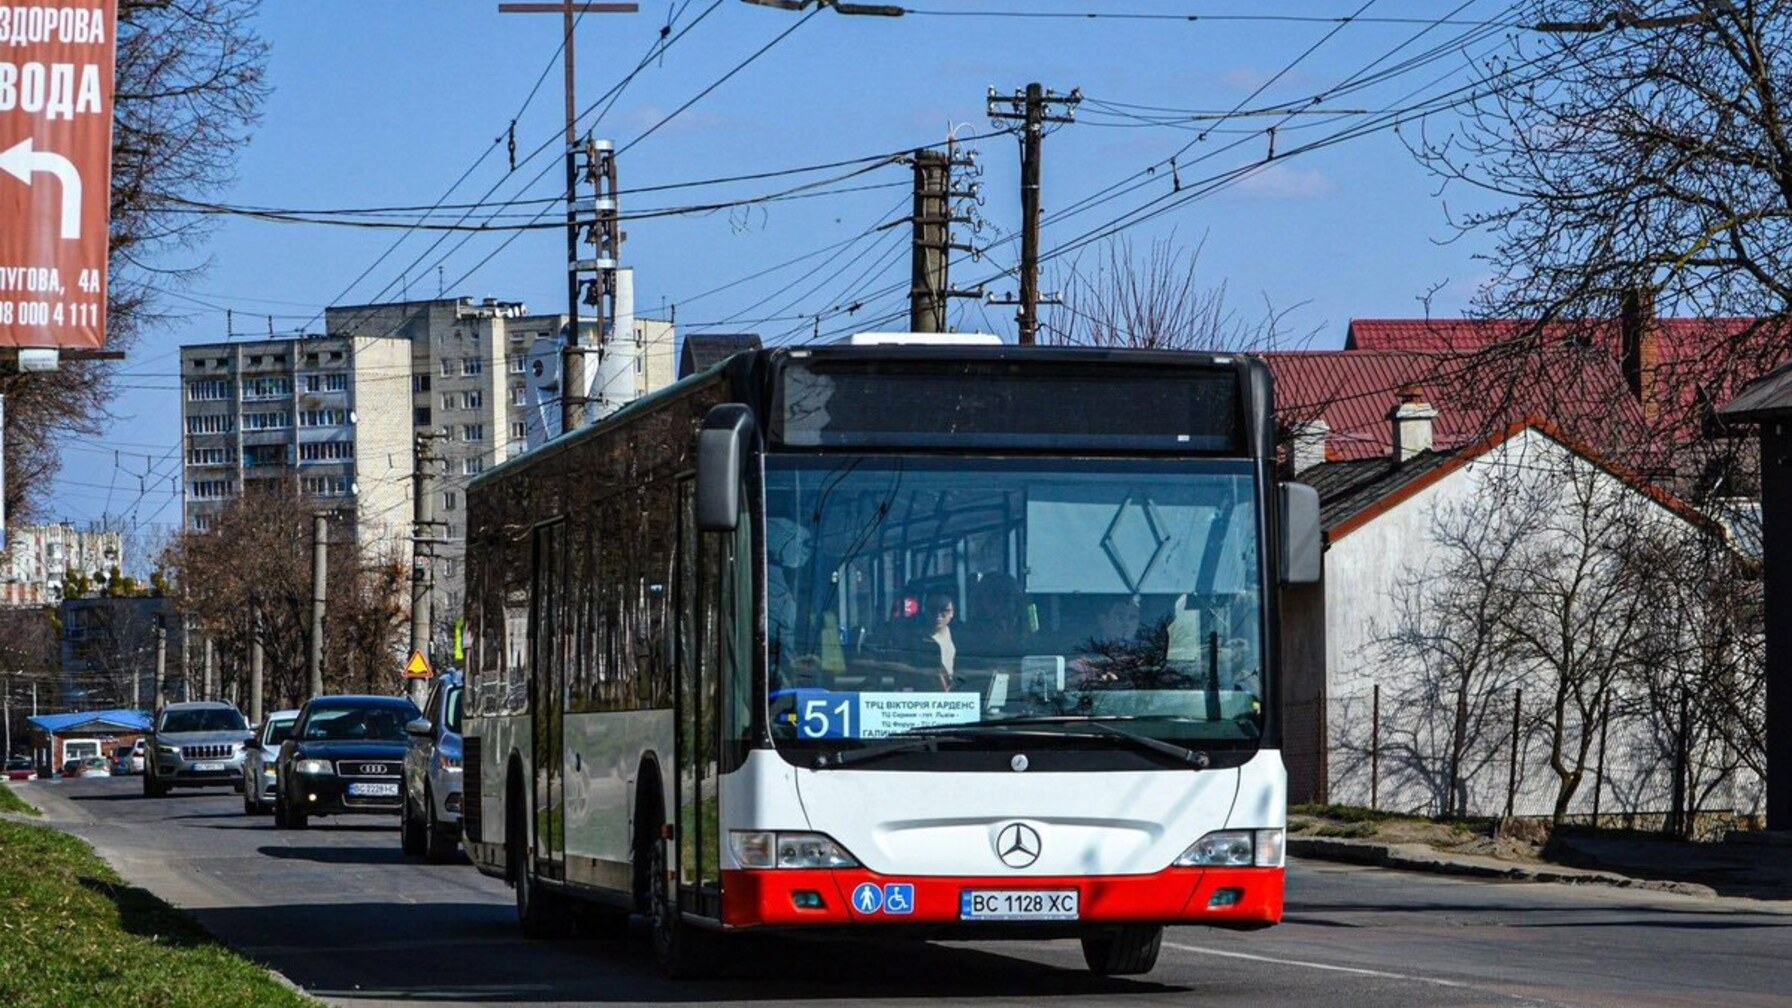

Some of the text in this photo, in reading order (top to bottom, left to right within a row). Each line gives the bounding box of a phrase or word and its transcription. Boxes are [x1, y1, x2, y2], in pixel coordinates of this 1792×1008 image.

[0, 6, 105, 47] ЗДОРОВА
[0, 61, 102, 120] ВОДА
[78, 268, 100, 293] 4А
[18, 301, 48, 326] 000
[865, 701, 975, 711] ТРЦ ВІКТОРІЯ ГАРДЕНС
[804, 700, 849, 738] 51
[973, 895, 1073, 912] BC 1128 XC
